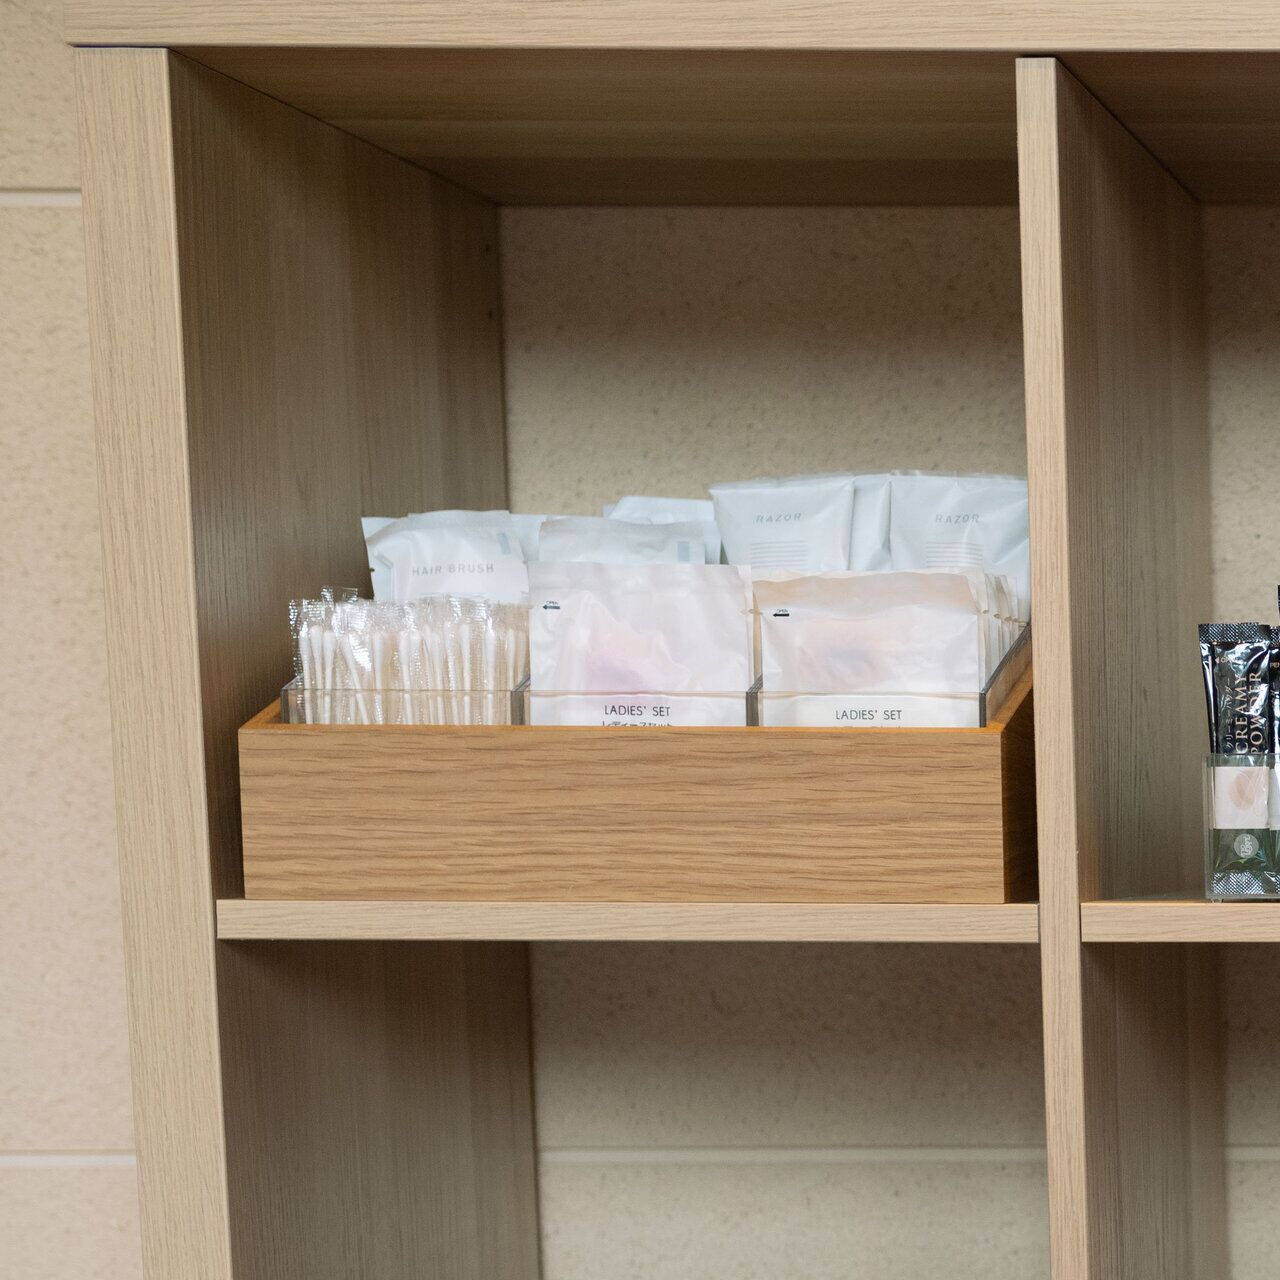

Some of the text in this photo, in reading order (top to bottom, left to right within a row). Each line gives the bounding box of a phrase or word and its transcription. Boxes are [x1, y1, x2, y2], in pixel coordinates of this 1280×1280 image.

[756, 512, 802, 524] RAZOR
[935, 513, 980, 525] RAZOR
[412, 562, 495, 577] HAIR BRUSH
[604, 704, 671, 718] LADIES' SET
[835, 708, 902, 721] LADIES' SET
[1235, 676, 1249, 754] CREAMY
